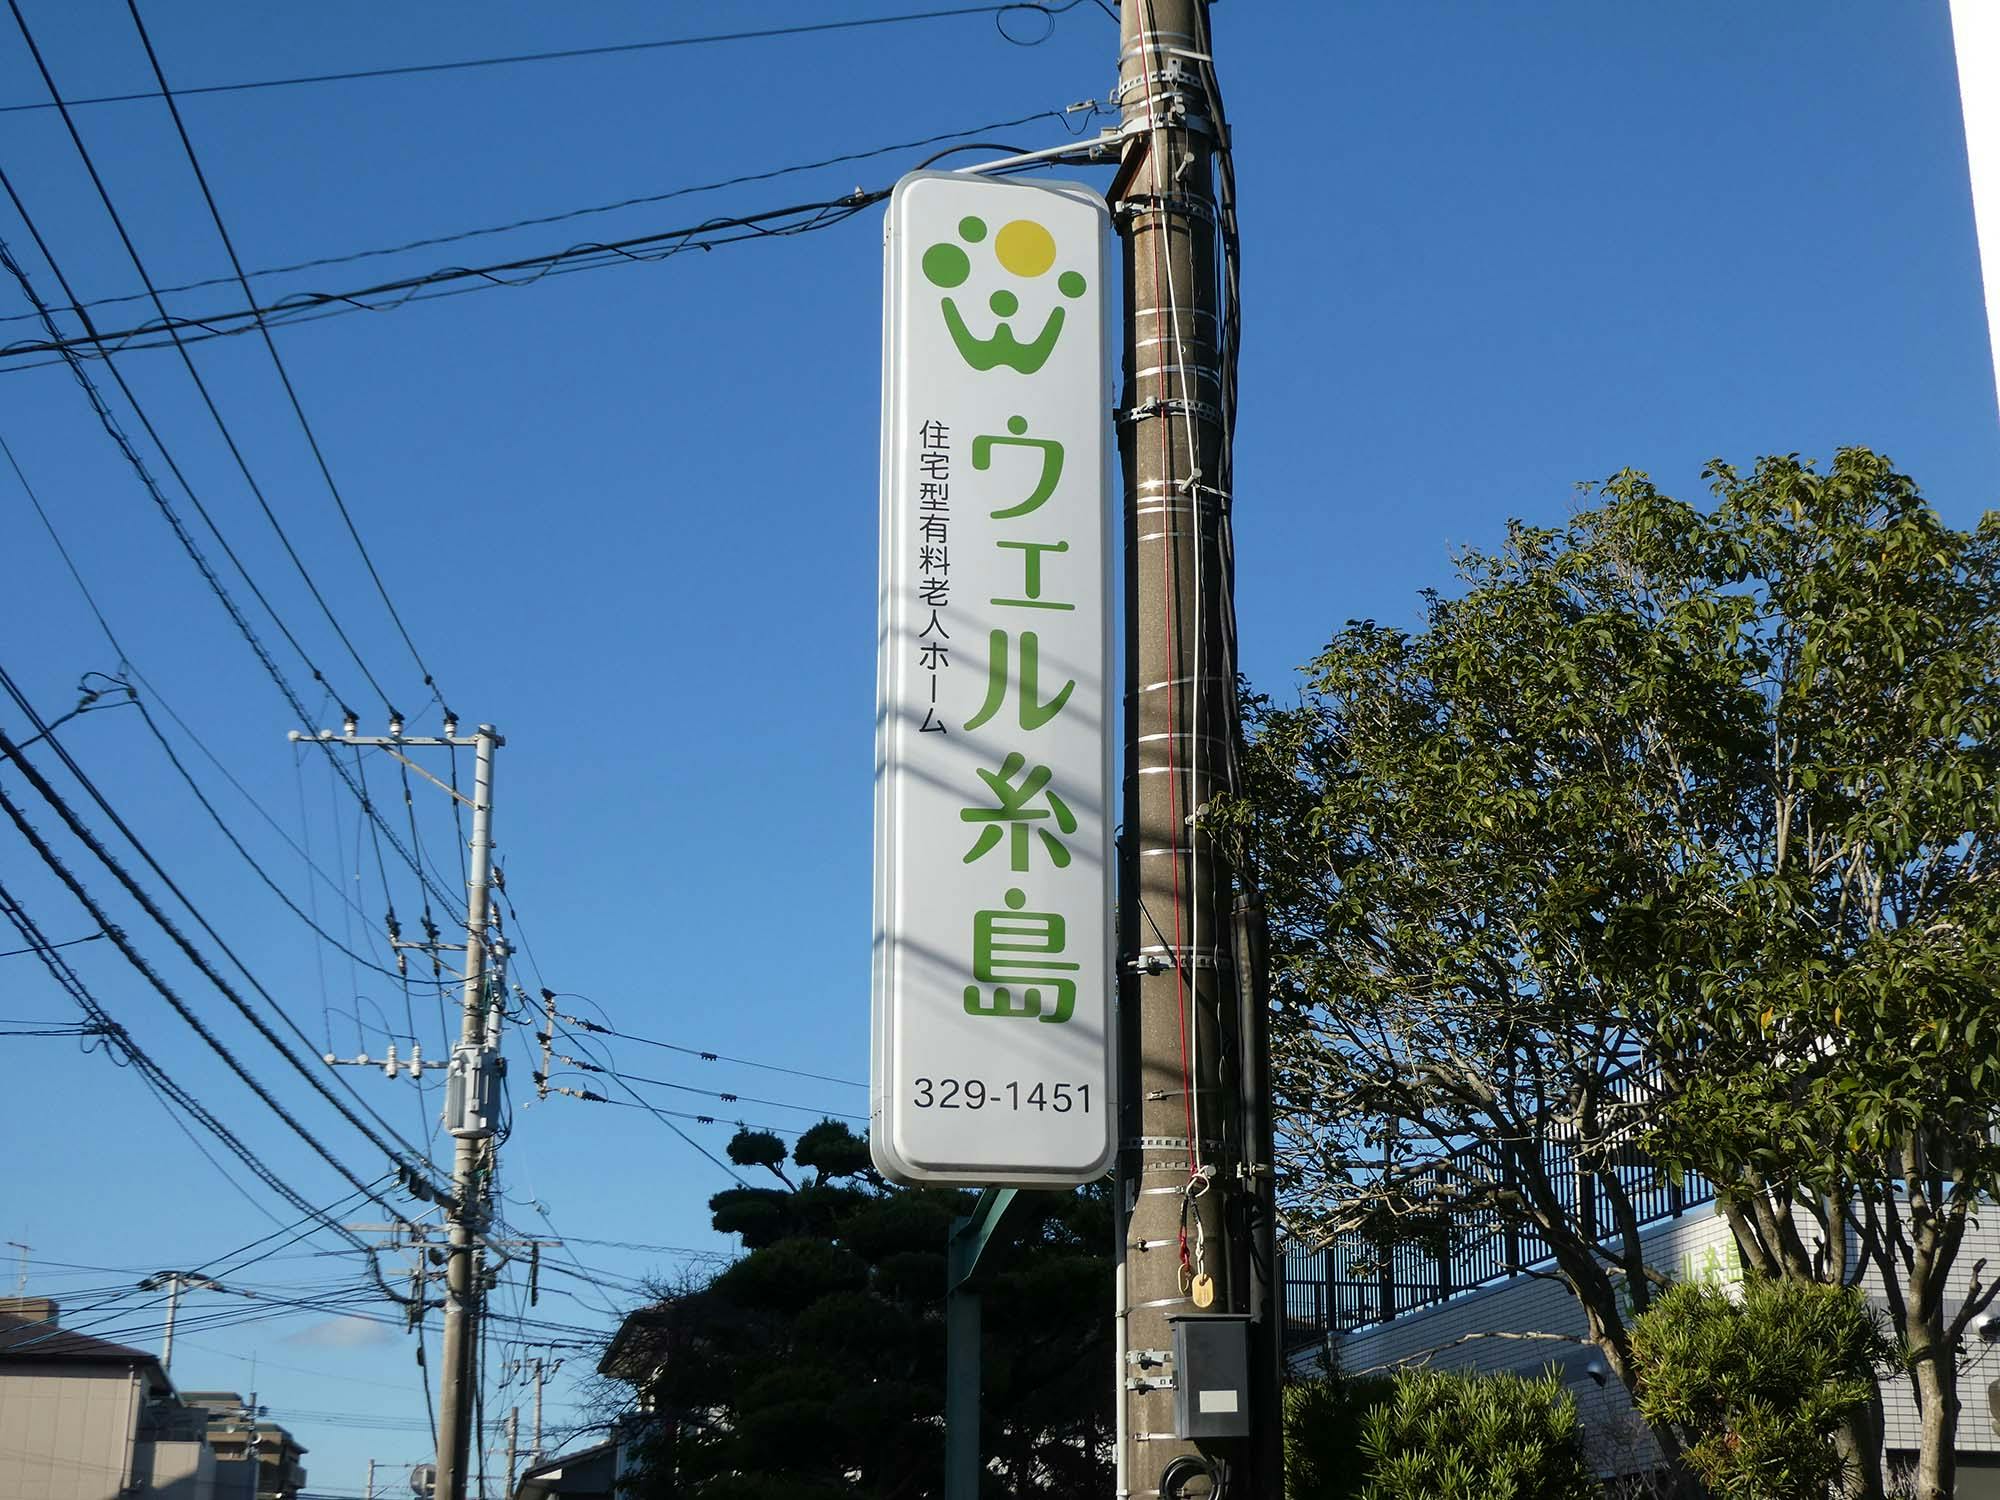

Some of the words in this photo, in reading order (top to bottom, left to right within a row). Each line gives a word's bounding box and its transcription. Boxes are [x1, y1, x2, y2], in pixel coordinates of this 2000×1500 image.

[918, 419, 951, 737] 住宅型有料老人ホーム
[913, 1078, 1091, 1114] 329-1451
